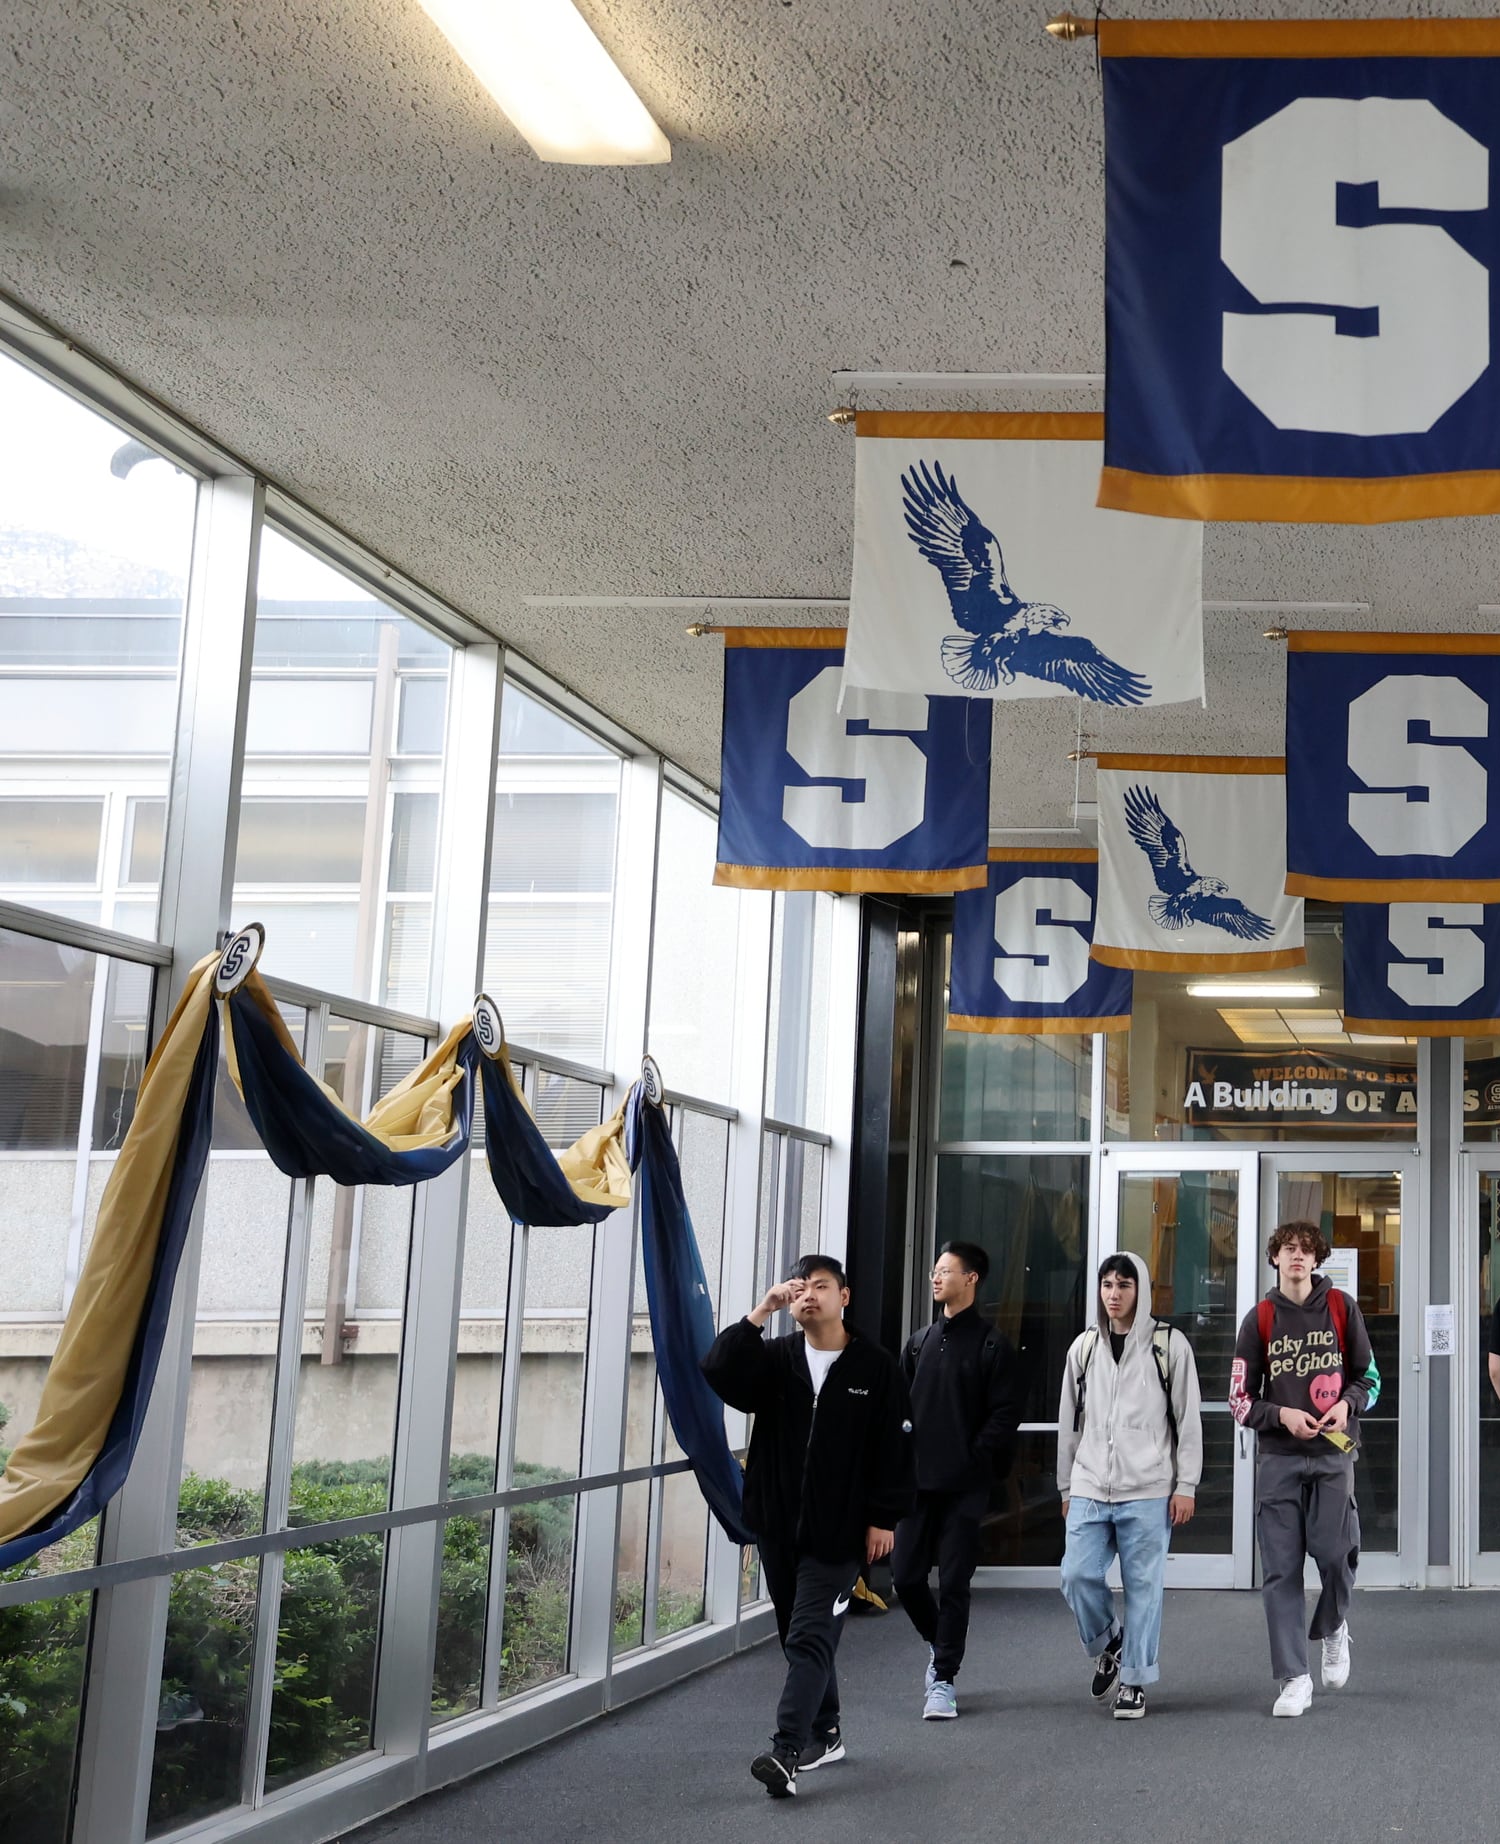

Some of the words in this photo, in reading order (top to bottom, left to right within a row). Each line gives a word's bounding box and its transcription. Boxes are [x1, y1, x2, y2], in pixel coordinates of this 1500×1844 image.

[1220, 97, 1490, 437] S
[782, 665, 931, 850] S
[1346, 674, 1490, 857] S
[220, 936, 251, 980] S
[993, 876, 1093, 1003] S
[1387, 902, 1485, 1006] S
[1183, 1081, 1207, 1108] A
[1213, 1080, 1338, 1115] Building
[1252, 1066, 1348, 1082] WELCOME
[1353, 1069, 1379, 1082] TO
[1346, 1089, 1386, 1113] OF
[1395, 1089, 1480, 1113] AS
[1306, 1330, 1334, 1346] me
